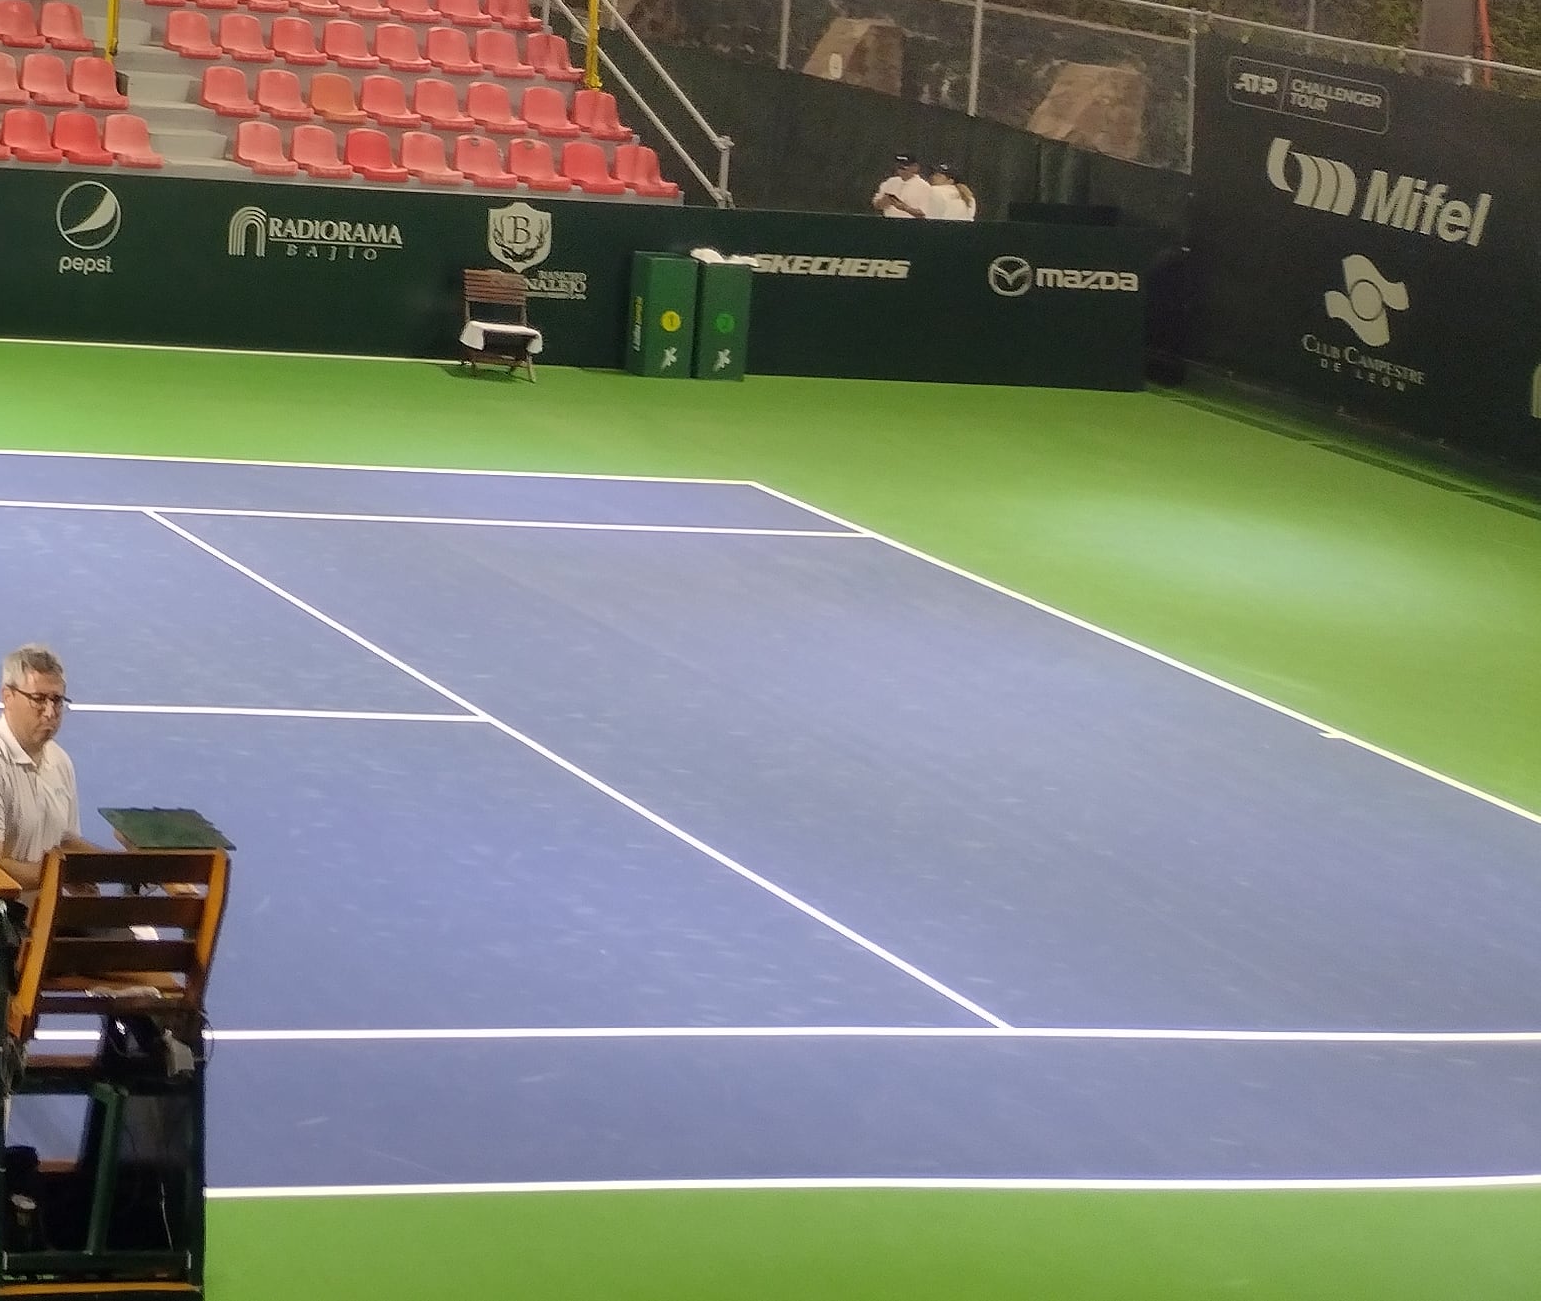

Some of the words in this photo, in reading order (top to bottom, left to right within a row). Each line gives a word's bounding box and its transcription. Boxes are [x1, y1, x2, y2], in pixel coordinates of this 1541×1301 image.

[1234, 72, 1278, 95] ATP
[1291, 78, 1383, 109] CHALLENGER
[1290, 91, 1329, 113] TOUR
[1360, 169, 1494, 247] Mifel
[268, 217, 403, 245] RADIORAMA
[507, 215, 531, 245] B
[58, 255, 114, 276] pepsi
[751, 253, 912, 279] SKECHERS
